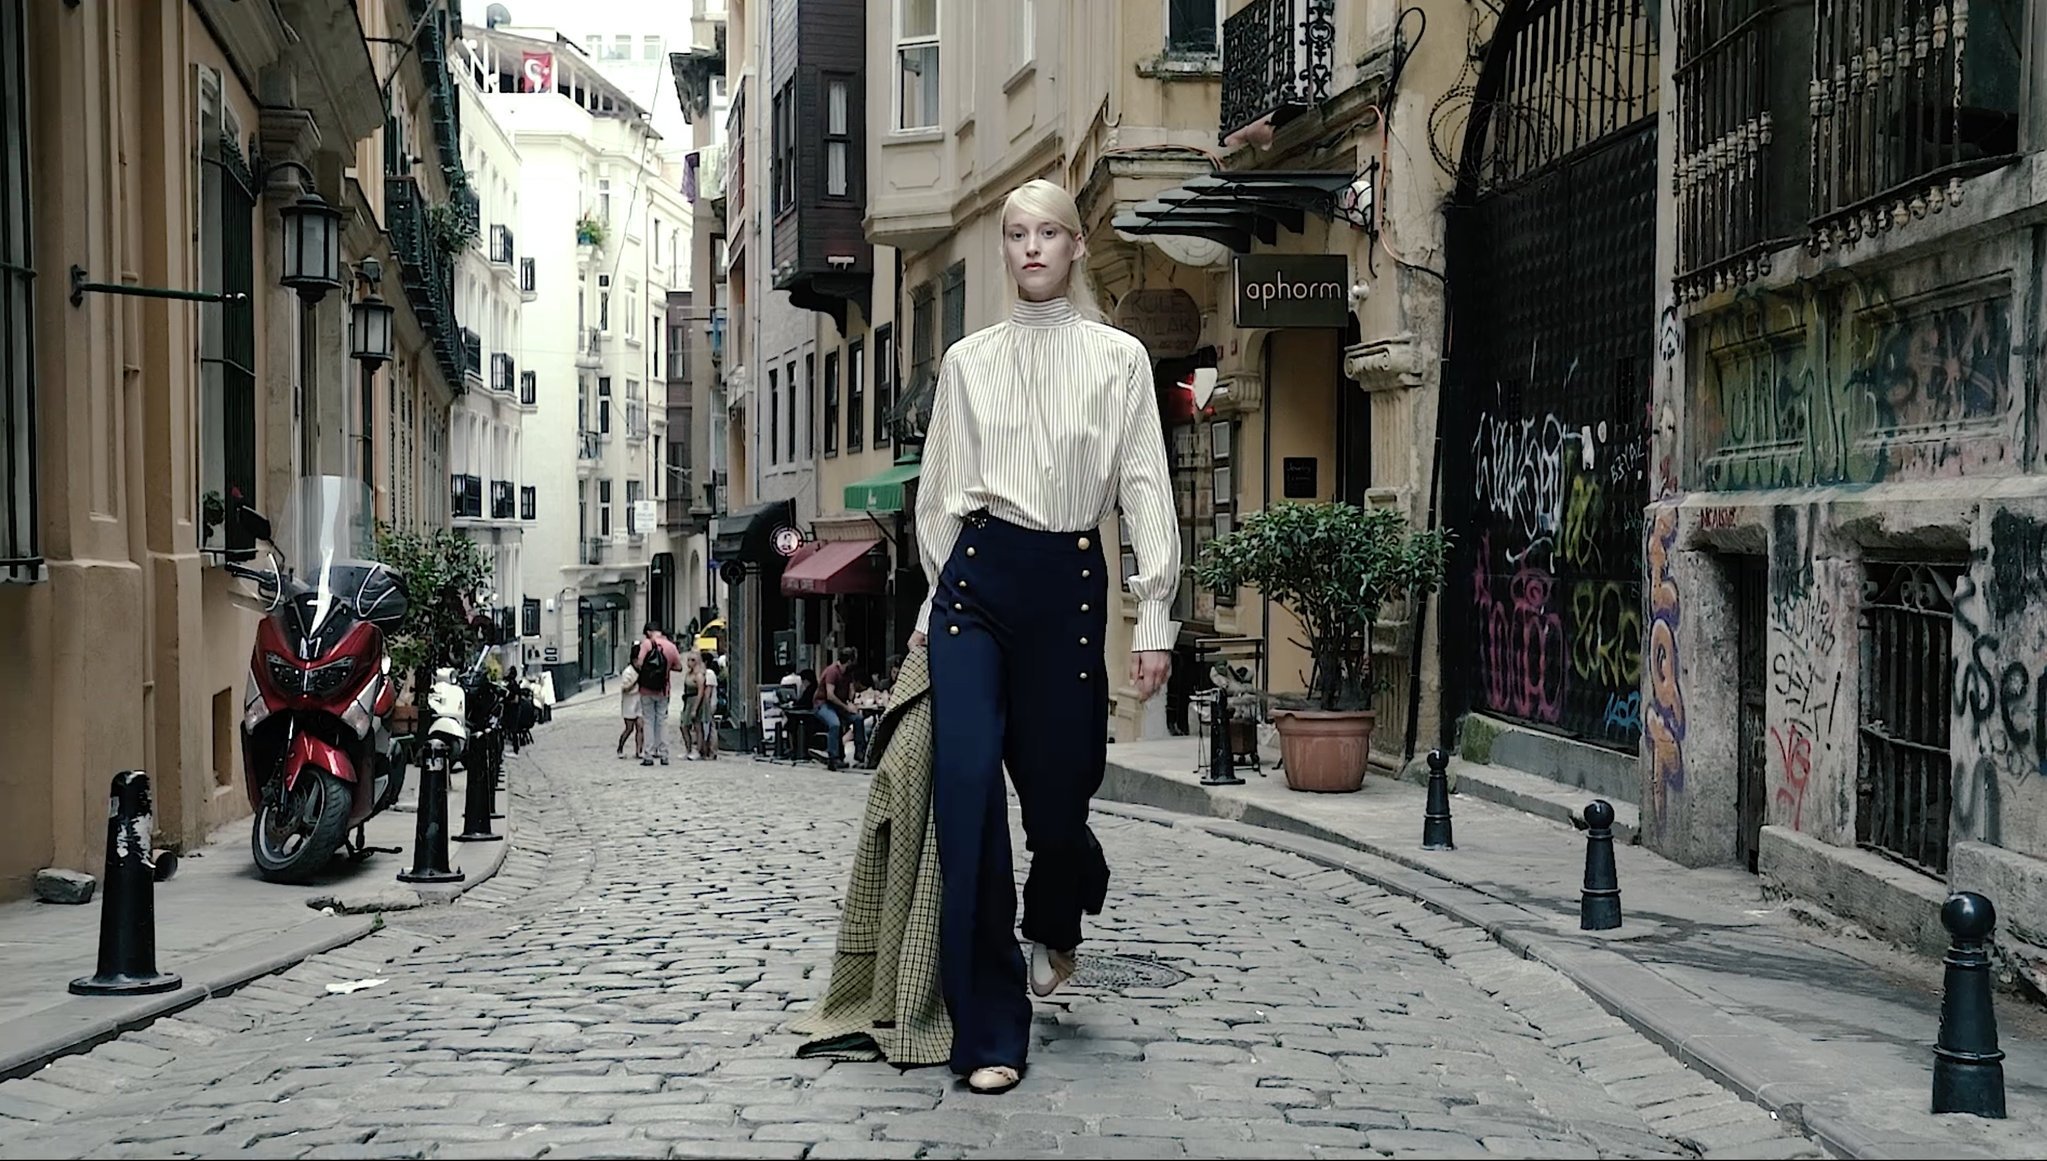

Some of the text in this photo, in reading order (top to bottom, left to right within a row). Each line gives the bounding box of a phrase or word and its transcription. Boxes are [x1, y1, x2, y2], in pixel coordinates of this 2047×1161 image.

[1246, 270, 1341, 311] aphorm
[1130, 295, 1186, 313] KULE
[1121, 316, 1195, 336] EMLAK
